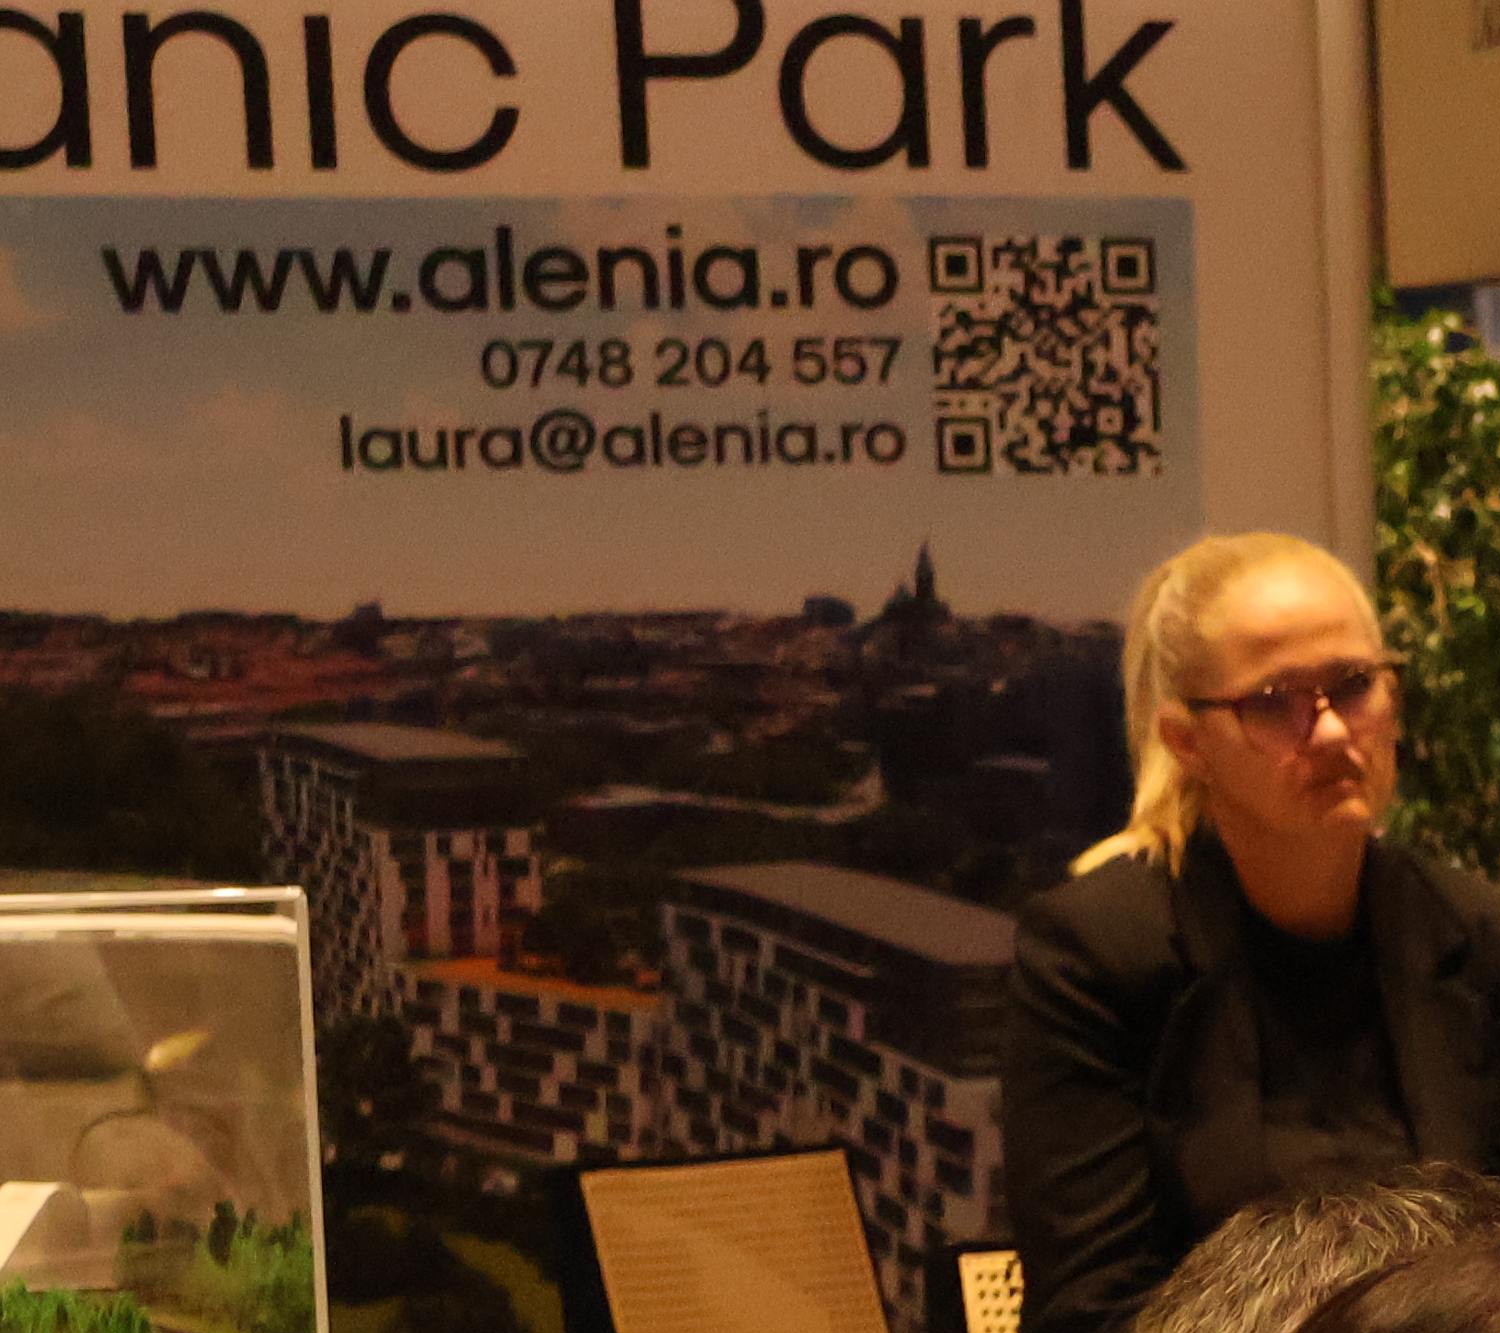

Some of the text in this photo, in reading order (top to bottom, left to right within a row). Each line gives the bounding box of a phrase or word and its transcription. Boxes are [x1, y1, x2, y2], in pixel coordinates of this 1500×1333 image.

[613, 0, 1192, 173] Park
[101, 224, 902, 314] www.alenia.ro
[480, 336, 902, 389] 0748 204 557
[338, 406, 908, 474] laura@alenia.ro
